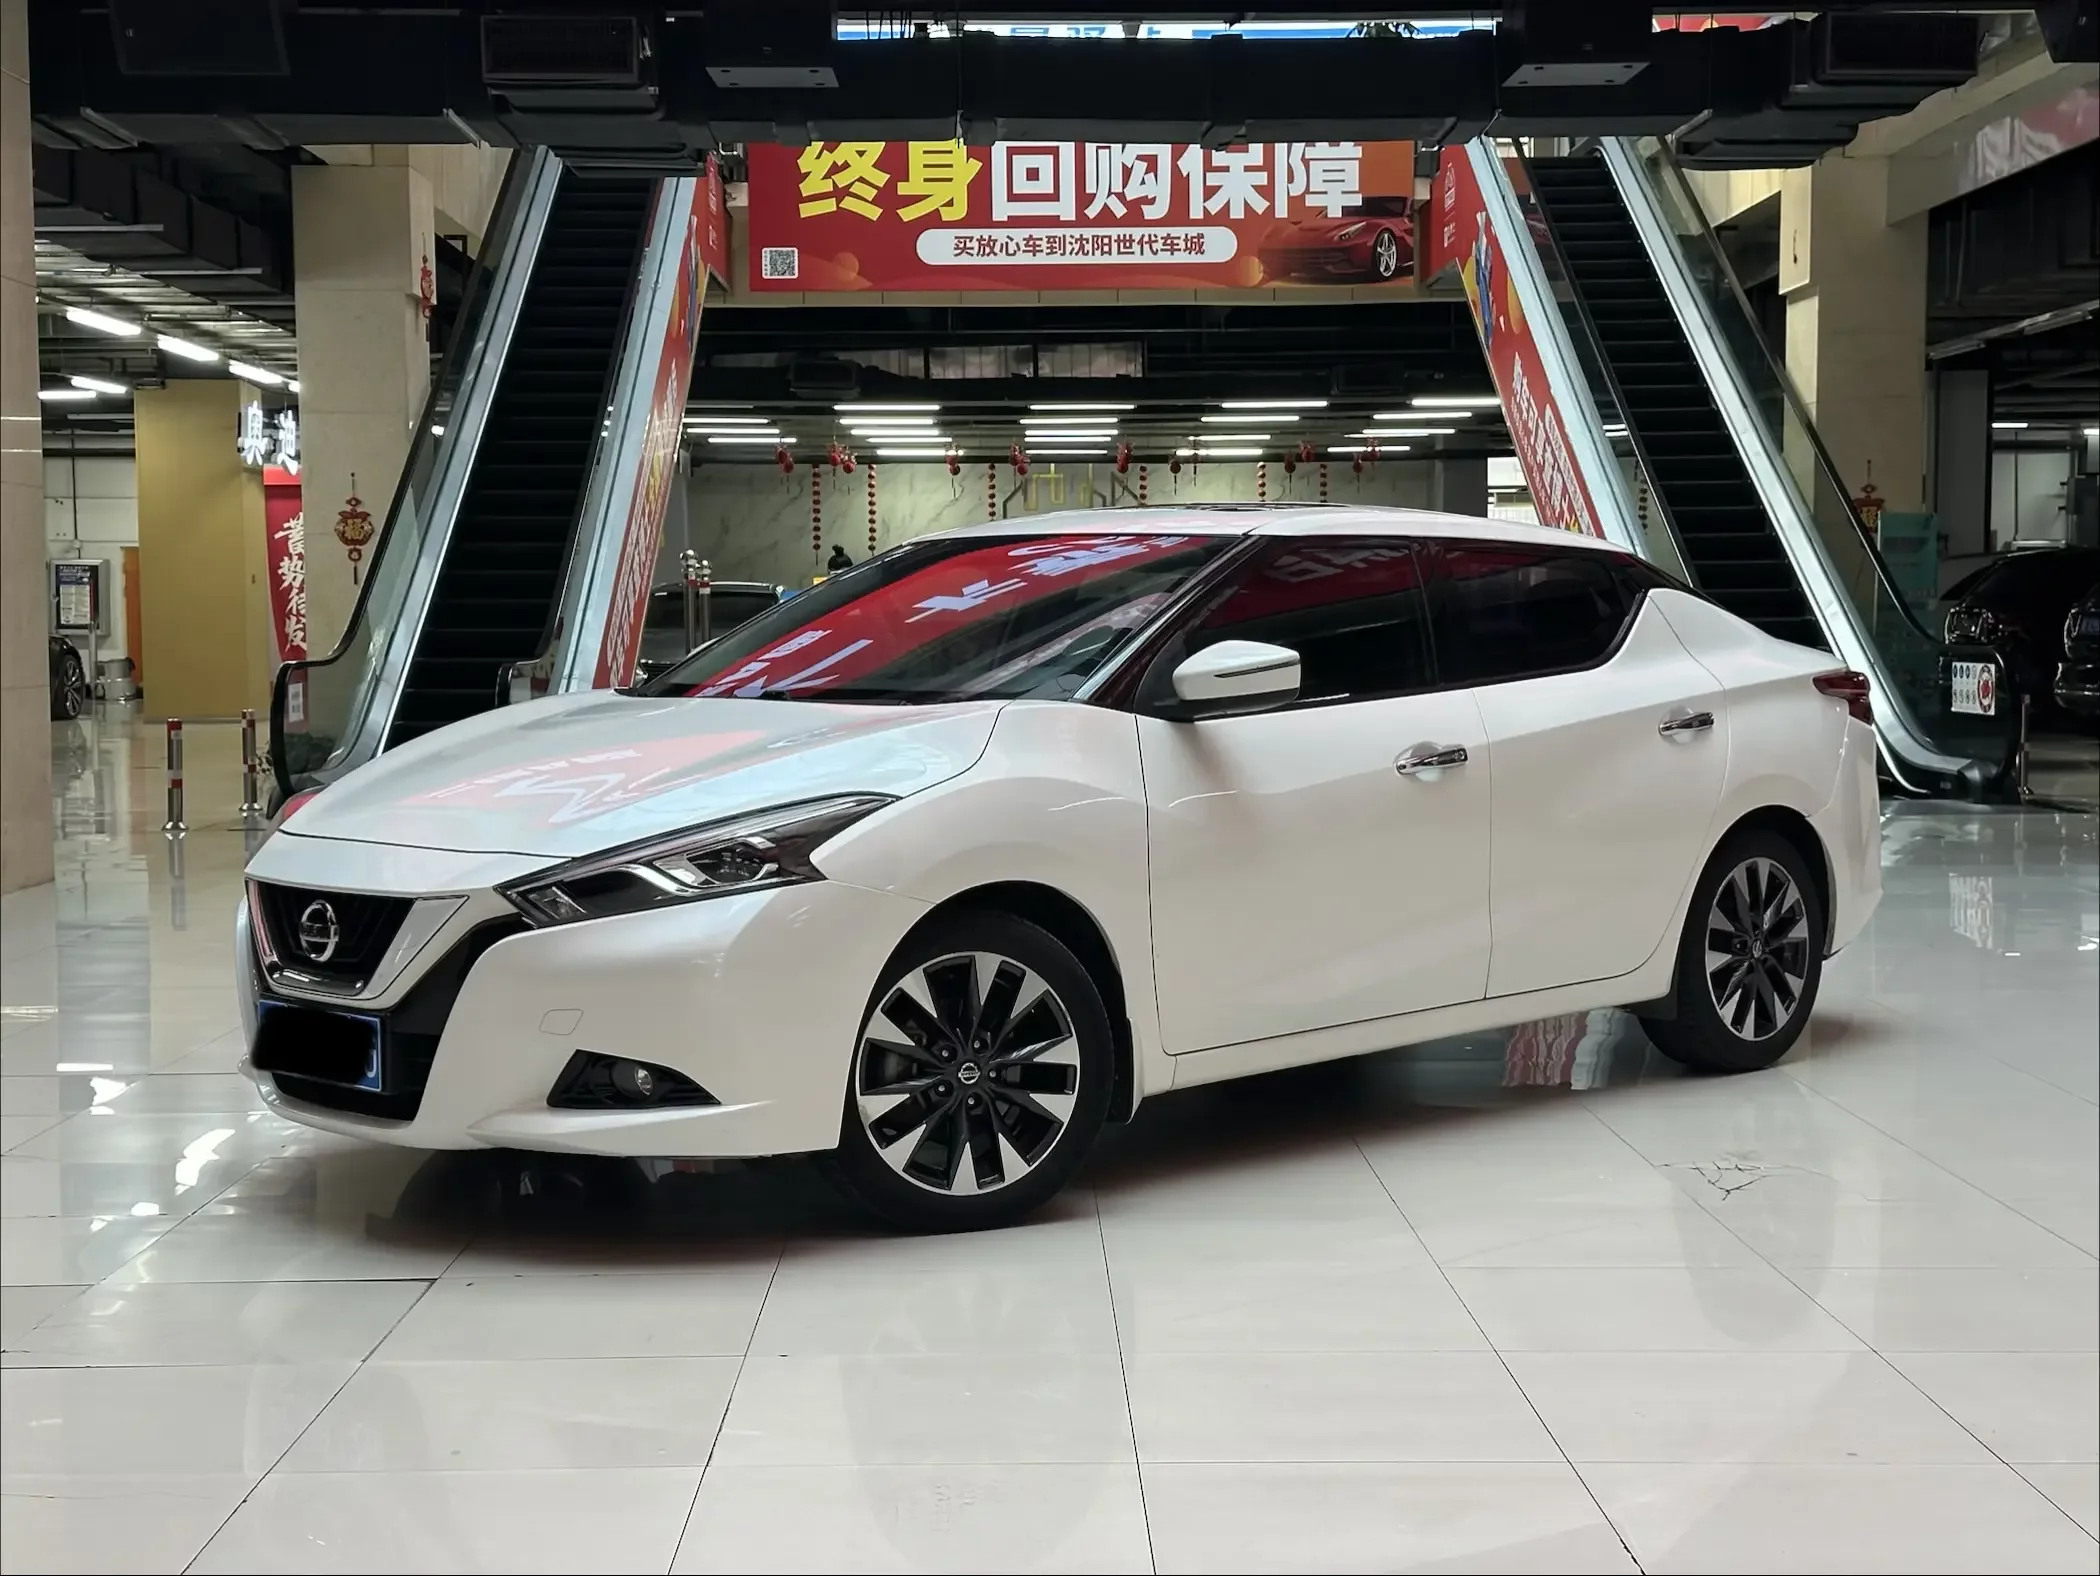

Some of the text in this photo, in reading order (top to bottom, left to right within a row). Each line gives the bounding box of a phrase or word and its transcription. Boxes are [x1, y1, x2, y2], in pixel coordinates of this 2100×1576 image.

[797, 138, 1363, 222] 终身回购保障
[953, 233, 1205, 257] 买放心车到沈阳世代车城
[241, 400, 298, 475] 奥迪
